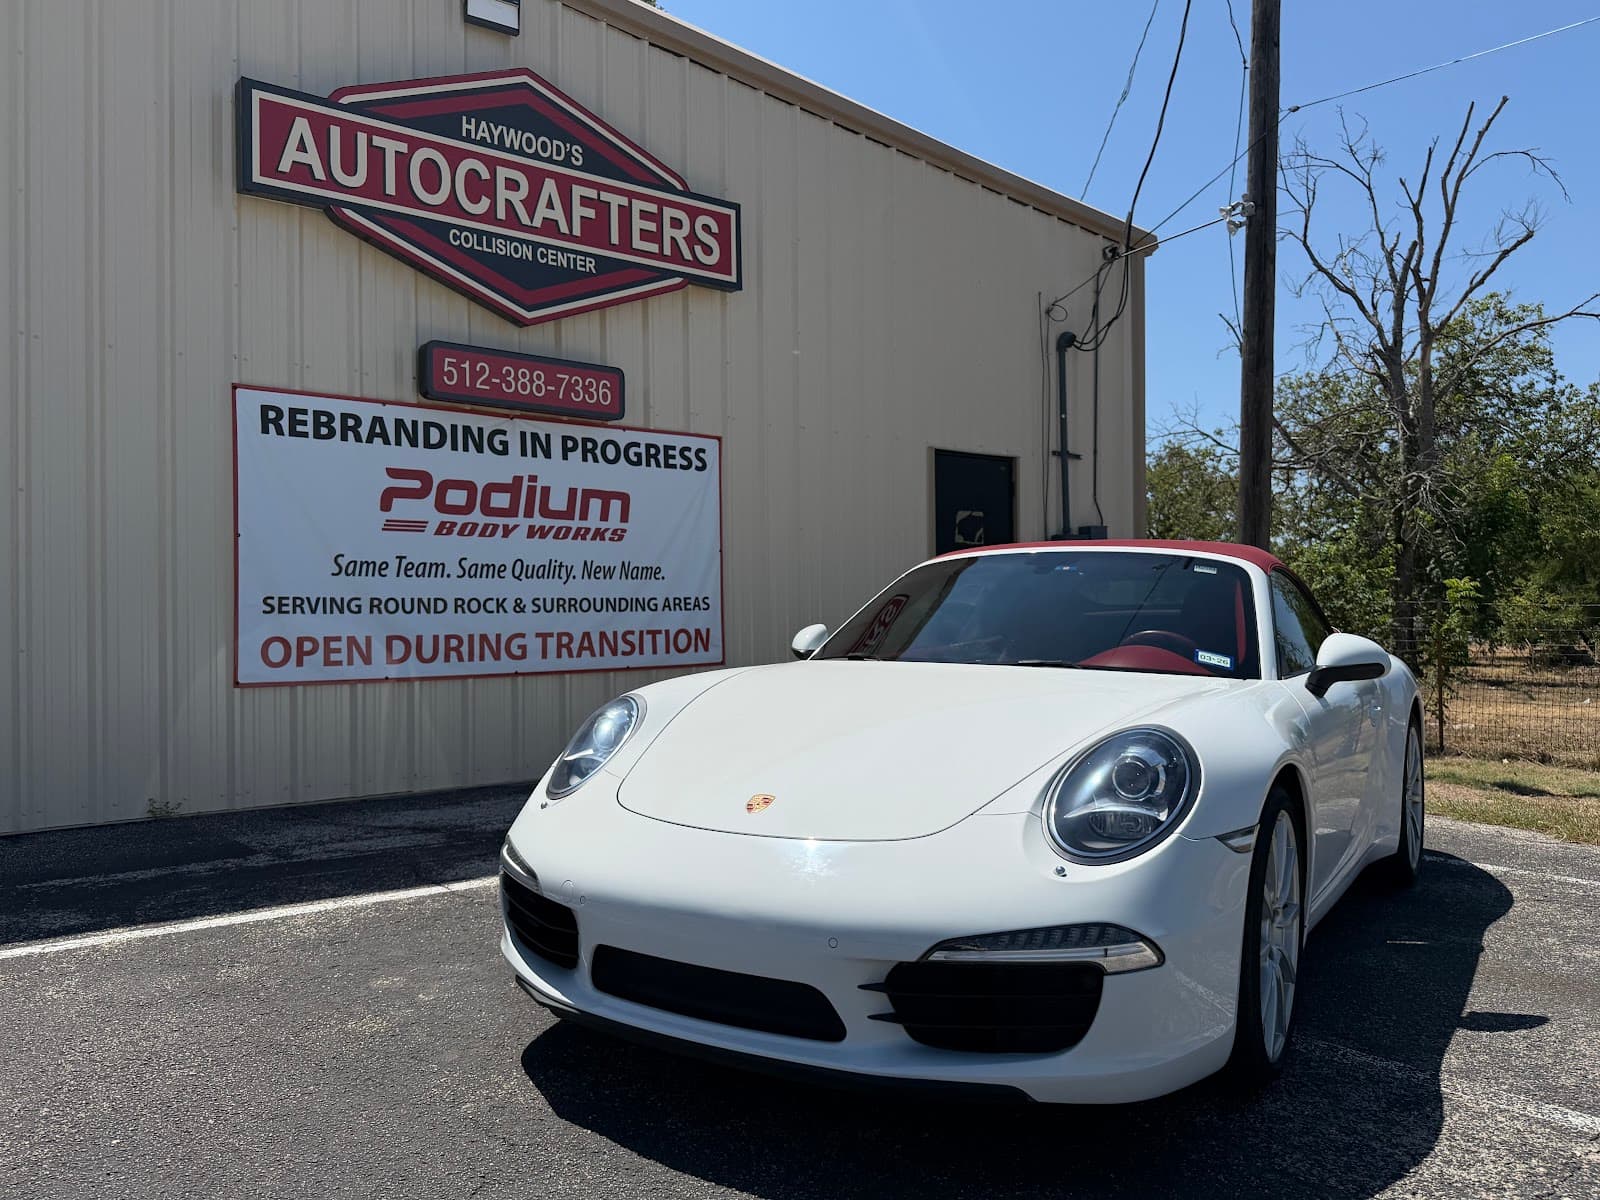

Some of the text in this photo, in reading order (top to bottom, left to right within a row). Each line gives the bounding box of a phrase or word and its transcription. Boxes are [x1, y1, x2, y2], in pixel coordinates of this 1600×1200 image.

[462, 115, 583, 166] HAYWOOD'S
[278, 116, 721, 265] AUTOCRAFTERS
[449, 229, 596, 274] COLLISION CENTER
[443, 357, 611, 405] 512-388-7336
[260, 404, 707, 472] REBRANDING IN PROGRESS
[380, 467, 630, 523] Podium
[434, 521, 627, 542] BODY WORKS
[331, 554, 665, 585] Same Team. Same Quality. New Name.
[262, 596, 710, 615] SERVING ROUND ROCK & SURROUNDING AREAS
[260, 628, 710, 669] OPEN DURING TRANSITION
